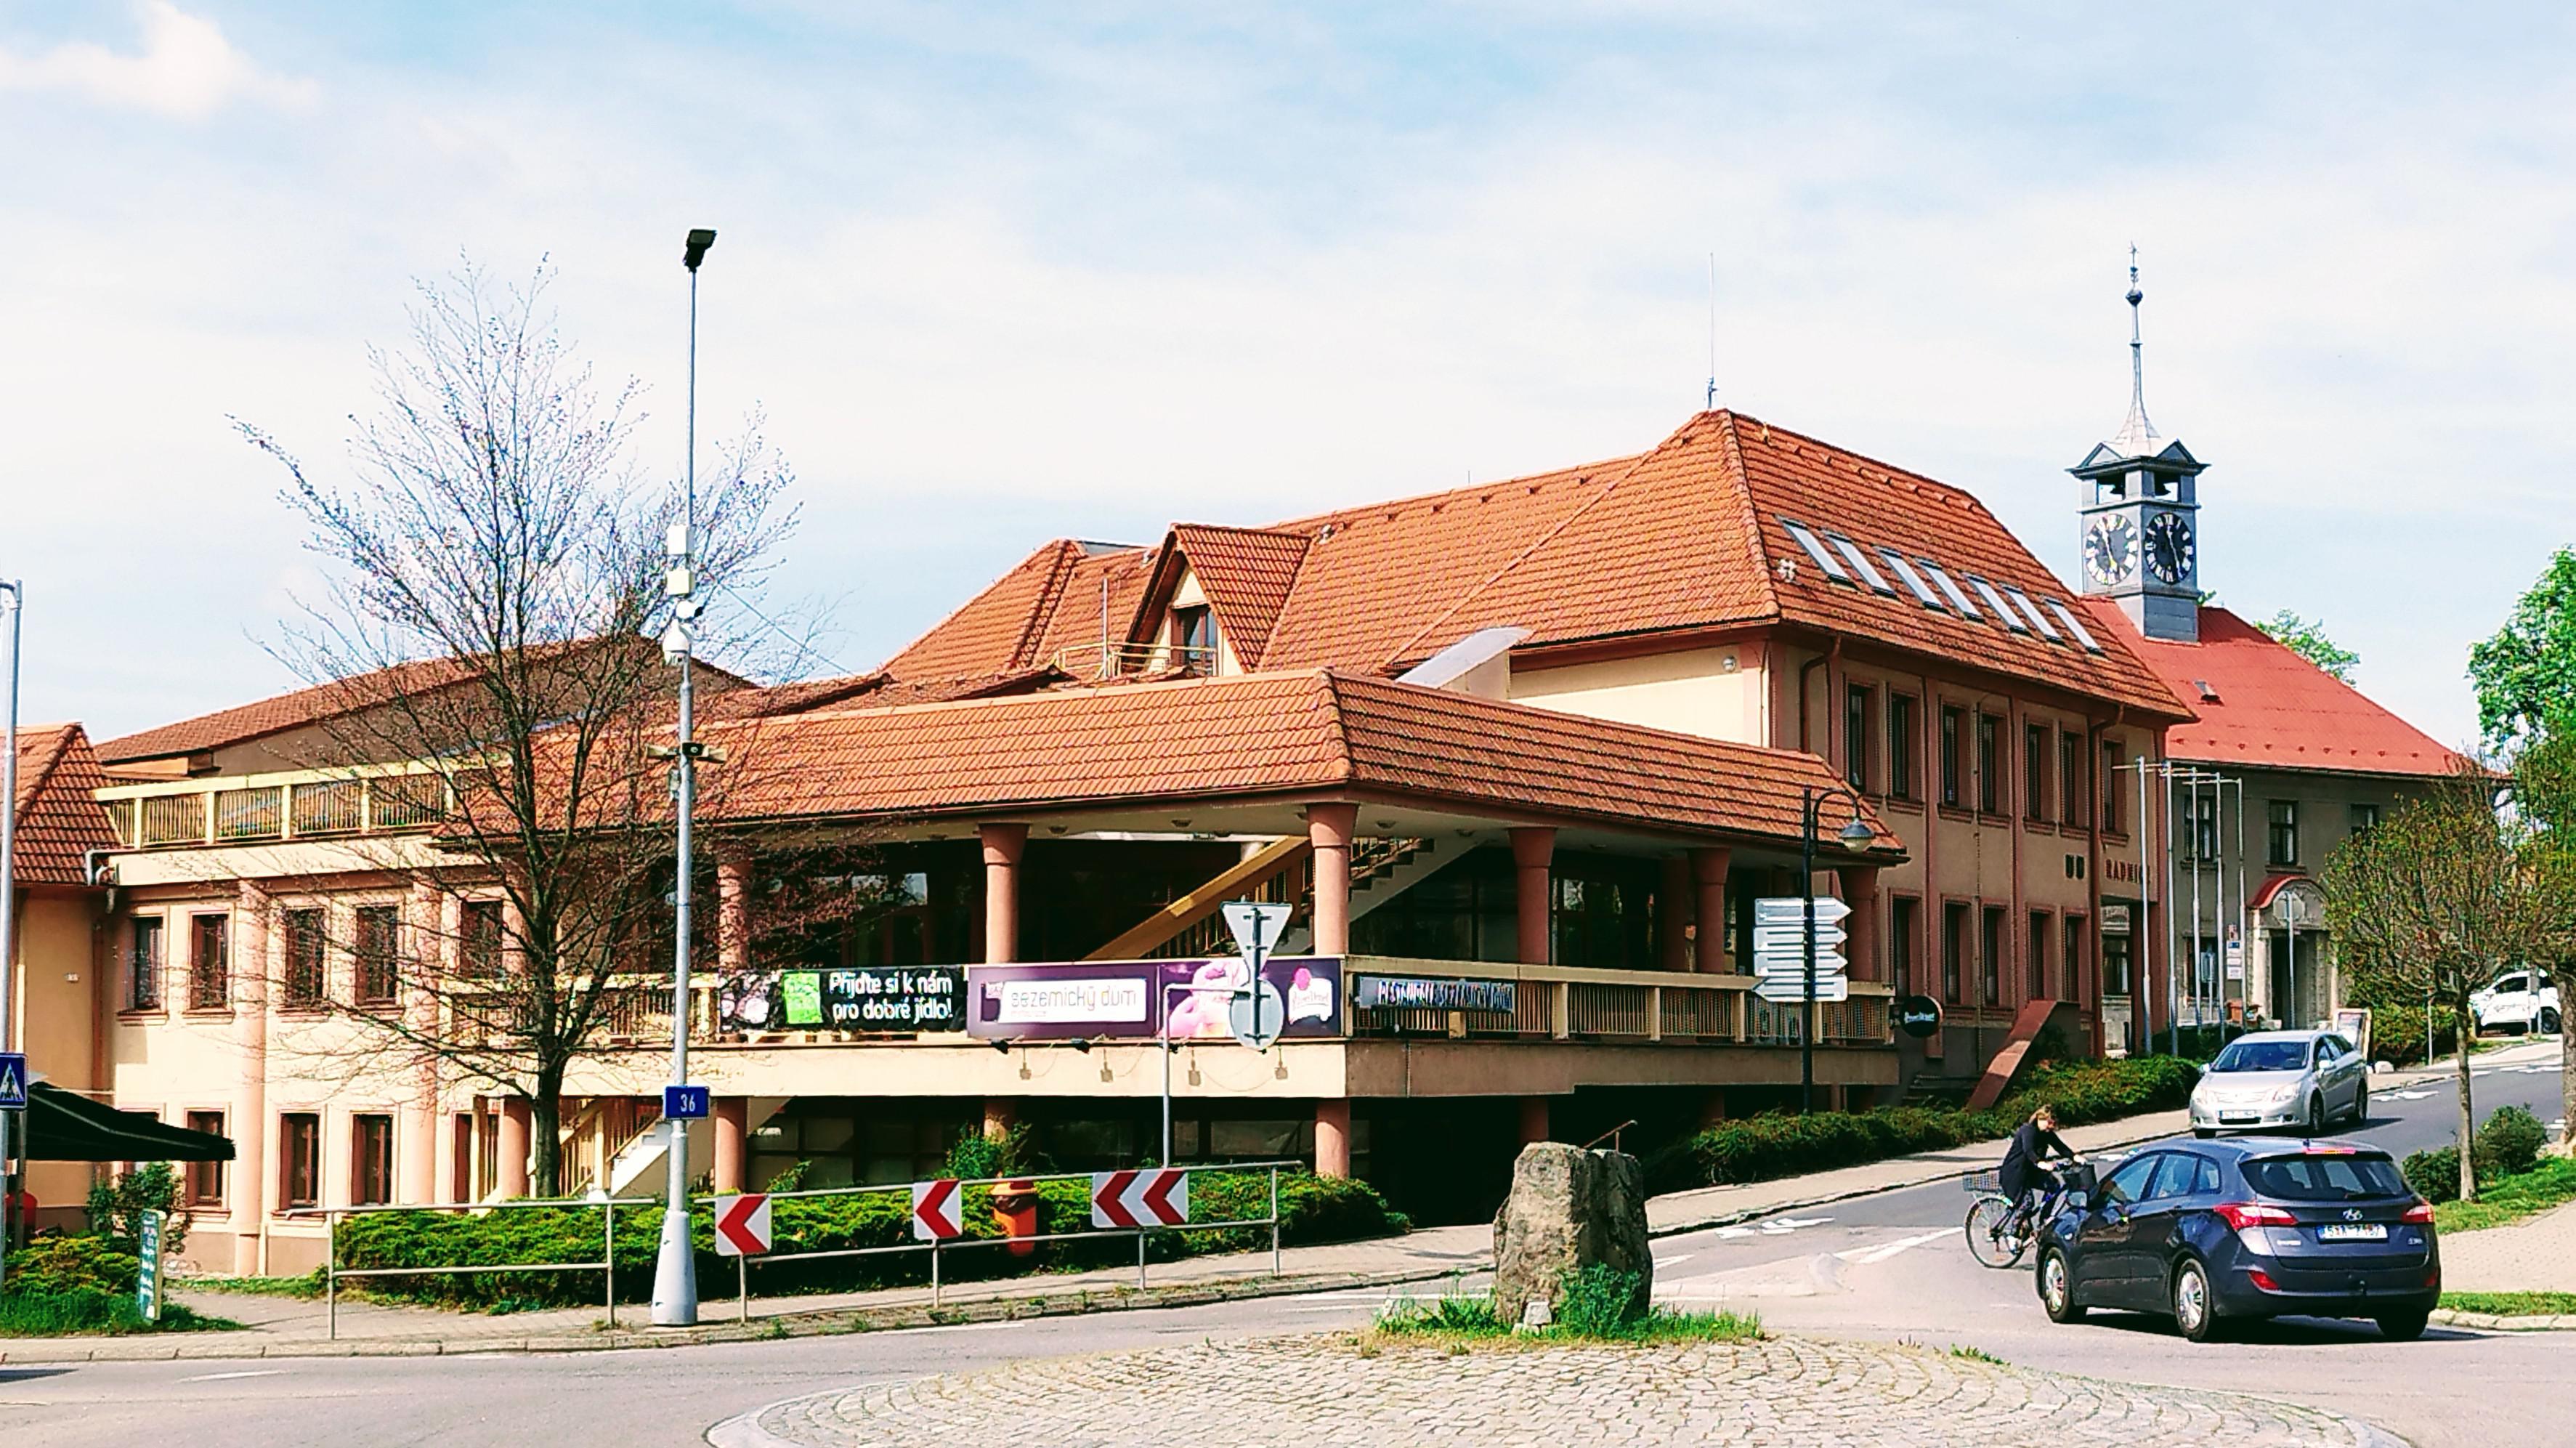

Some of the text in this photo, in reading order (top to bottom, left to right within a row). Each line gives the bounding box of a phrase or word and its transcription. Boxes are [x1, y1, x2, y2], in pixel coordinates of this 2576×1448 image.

[885, 970, 899, 994] si
[902, 971, 915, 994] k
[917, 969, 953, 995] nám
[833, 996, 954, 1024] pro dobré jídlo!
[680, 1093, 696, 1112] 36
